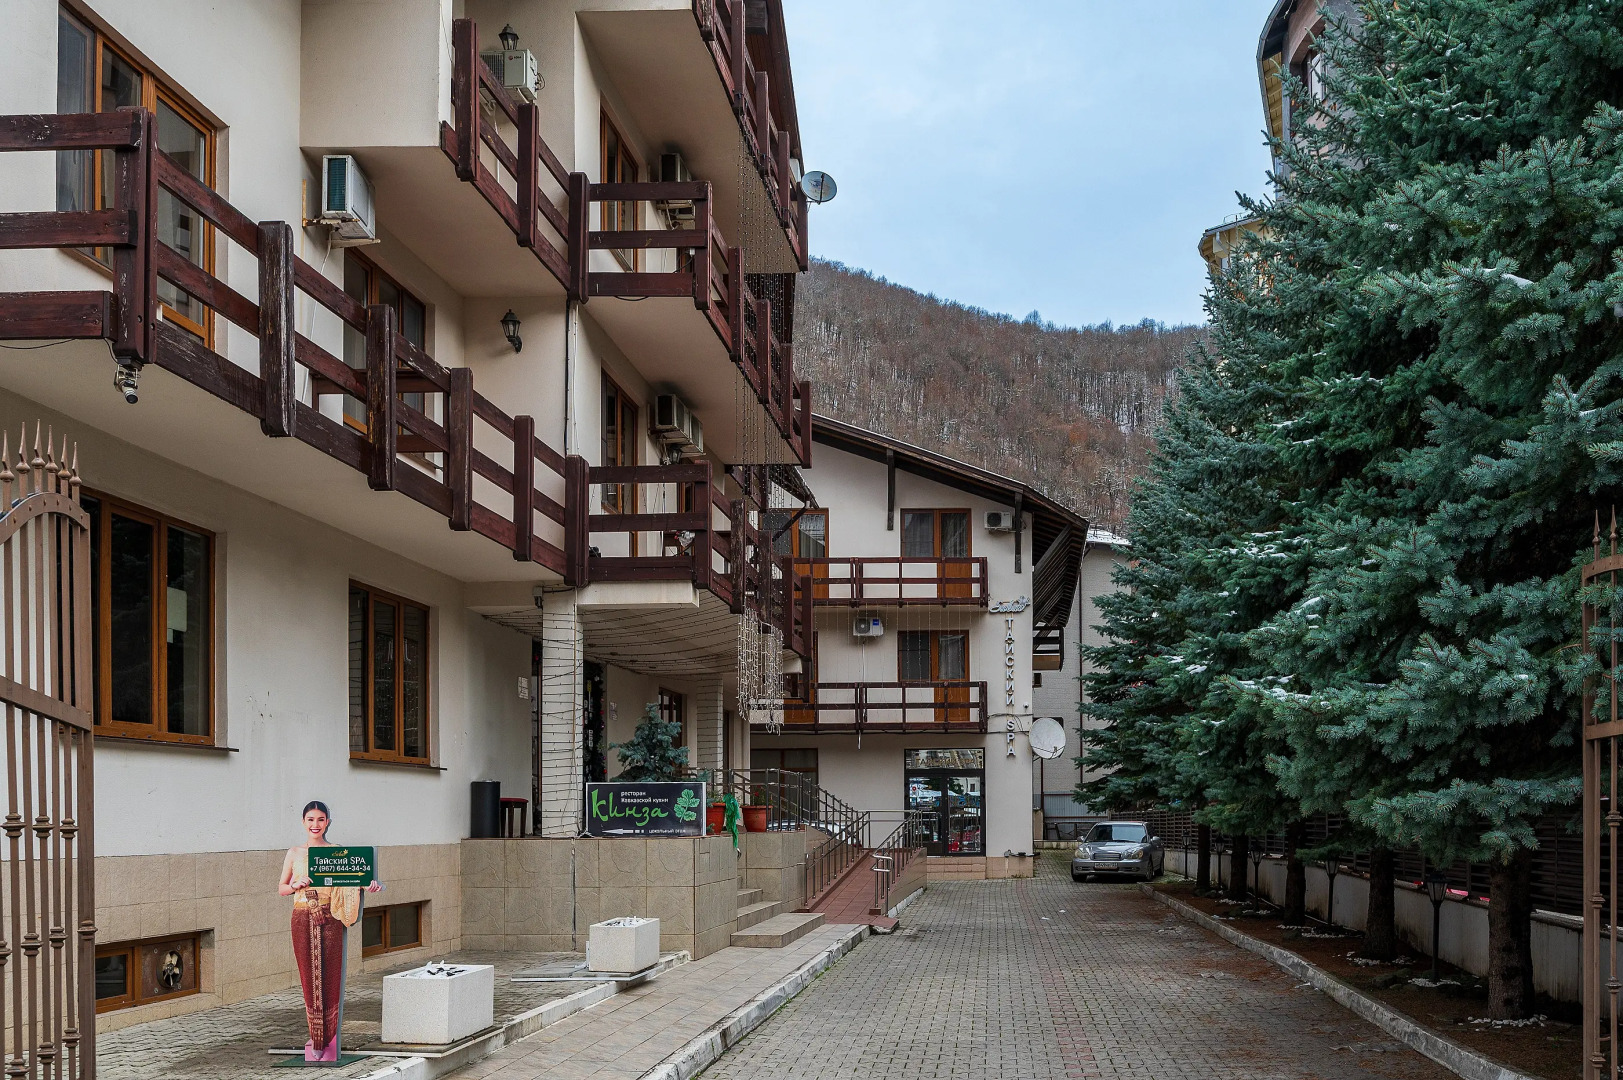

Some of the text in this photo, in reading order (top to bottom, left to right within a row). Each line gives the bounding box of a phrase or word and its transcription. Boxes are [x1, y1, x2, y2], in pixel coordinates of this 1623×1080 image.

[1005, 618, 1016, 758] ТАЙСКИЙ SPA
[314, 857, 366, 865] Тайский SPA
